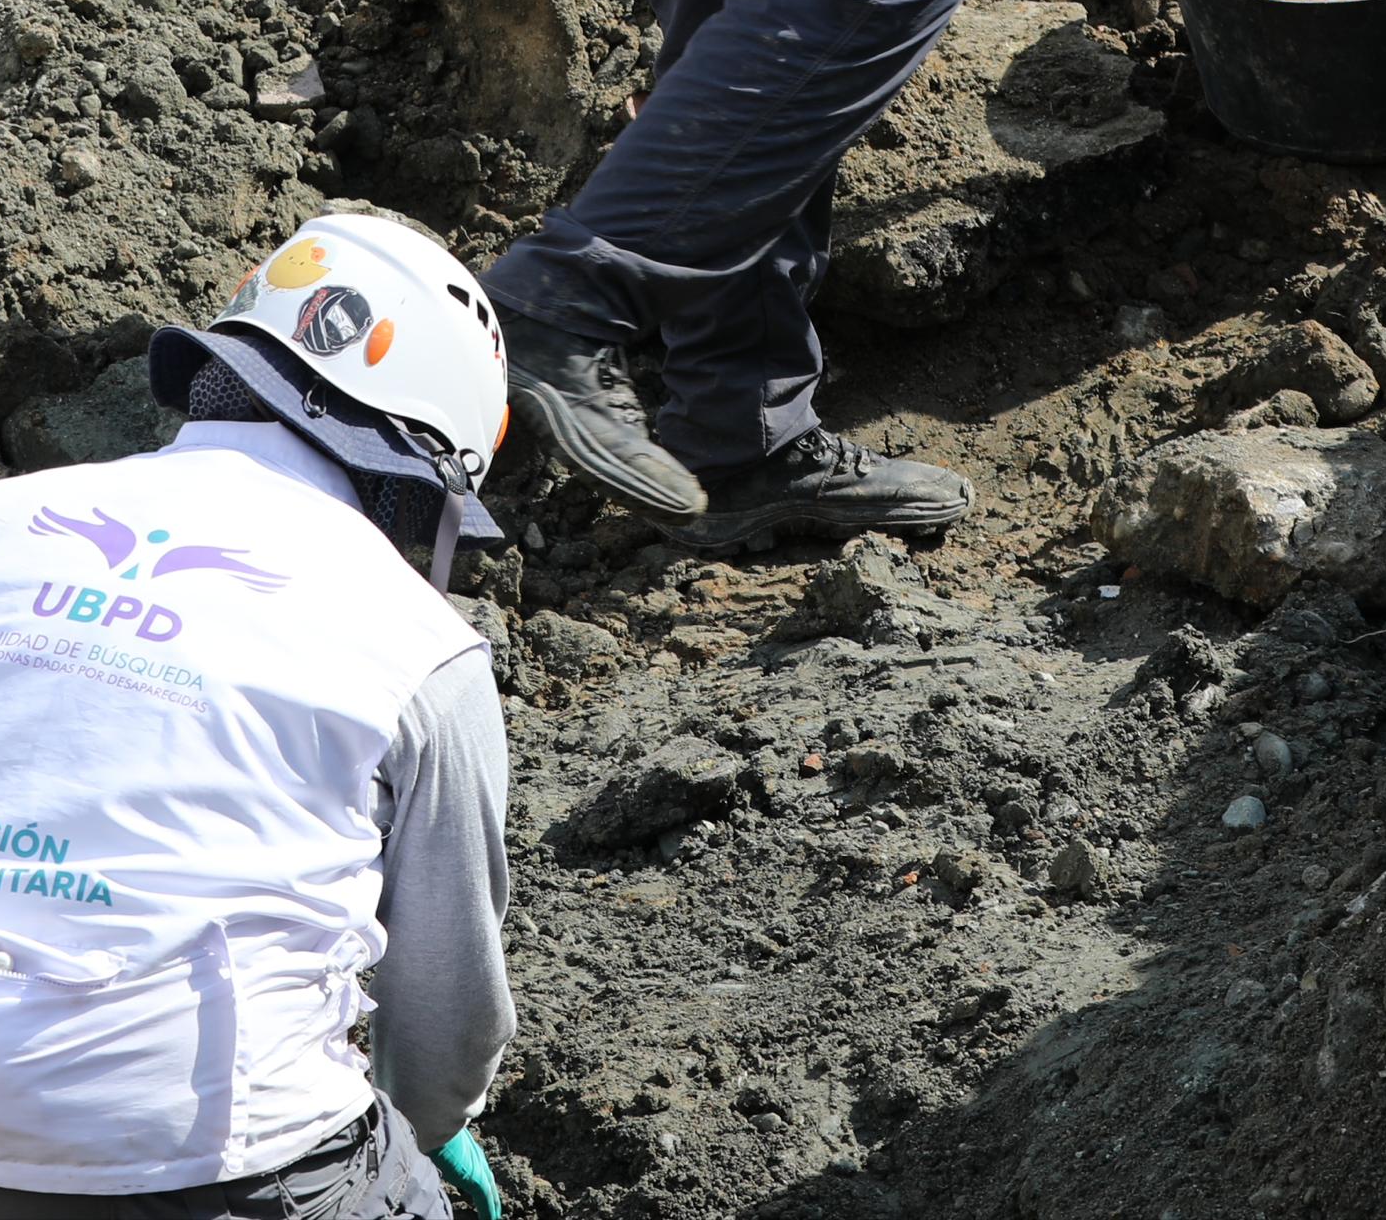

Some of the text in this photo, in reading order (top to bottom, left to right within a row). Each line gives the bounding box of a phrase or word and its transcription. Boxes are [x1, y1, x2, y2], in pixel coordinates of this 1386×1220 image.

[32, 581, 183, 643] UBPD
[33, 657, 74, 675] DADAS
[77, 665, 104, 682] POR
[107, 674, 209, 713] DESAPARECIDAS
[53, 638, 83, 659] DE
[88, 644, 203, 691] BÚSQUEDA
